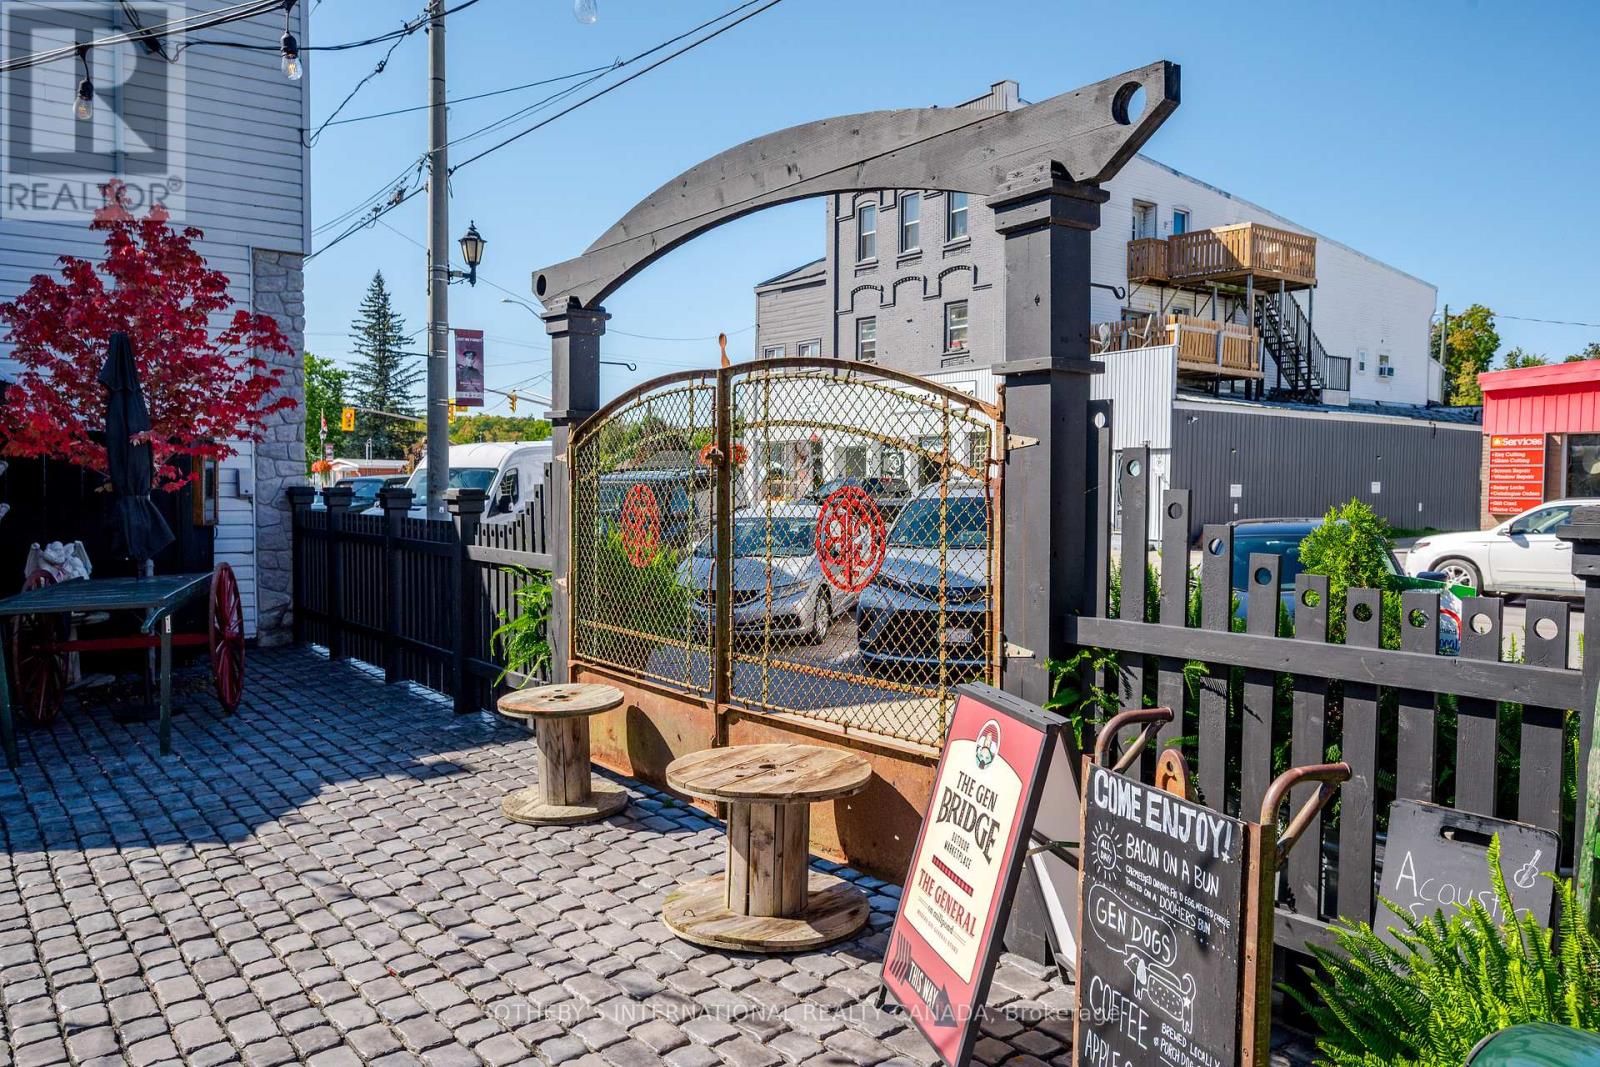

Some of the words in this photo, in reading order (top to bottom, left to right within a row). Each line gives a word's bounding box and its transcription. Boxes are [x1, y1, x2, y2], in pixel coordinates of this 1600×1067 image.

[1503, 438, 1543, 446] Services
[957, 770, 976, 798] THE
[975, 784, 998, 812] GEN
[936, 786, 1001, 865] BRIDGE
[1094, 769, 1142, 823] COME
[1145, 790, 1233, 862] ENJOY!
[943, 840, 972, 869] MARKETPLACE
[951, 831, 970, 852] OUTDOOR
[1125, 833, 1159, 868] BACON
[1163, 850, 1178, 877] ON
[1181, 859, 1190, 884] A
[1194, 864, 1220, 897] BUN
[917, 868, 935, 897] THE
[934, 885, 977, 938] GENERAL
[932, 910, 955, 934] millpond
[1143, 888, 1151, 899] ON
[1152, 893, 1157, 902] A
[1197, 918, 1211, 935] BUN
[1096, 897, 1127, 936] GEN
[1131, 916, 1171, 962] DOGS
[908, 961, 924, 993] THIS
[922, 977, 939, 1009] WAY
[1089, 975, 1149, 1050] COFFEE
[1161, 1022, 1187, 1047] BREWED
[1160, 1038, 1180, 1064] PORCH
